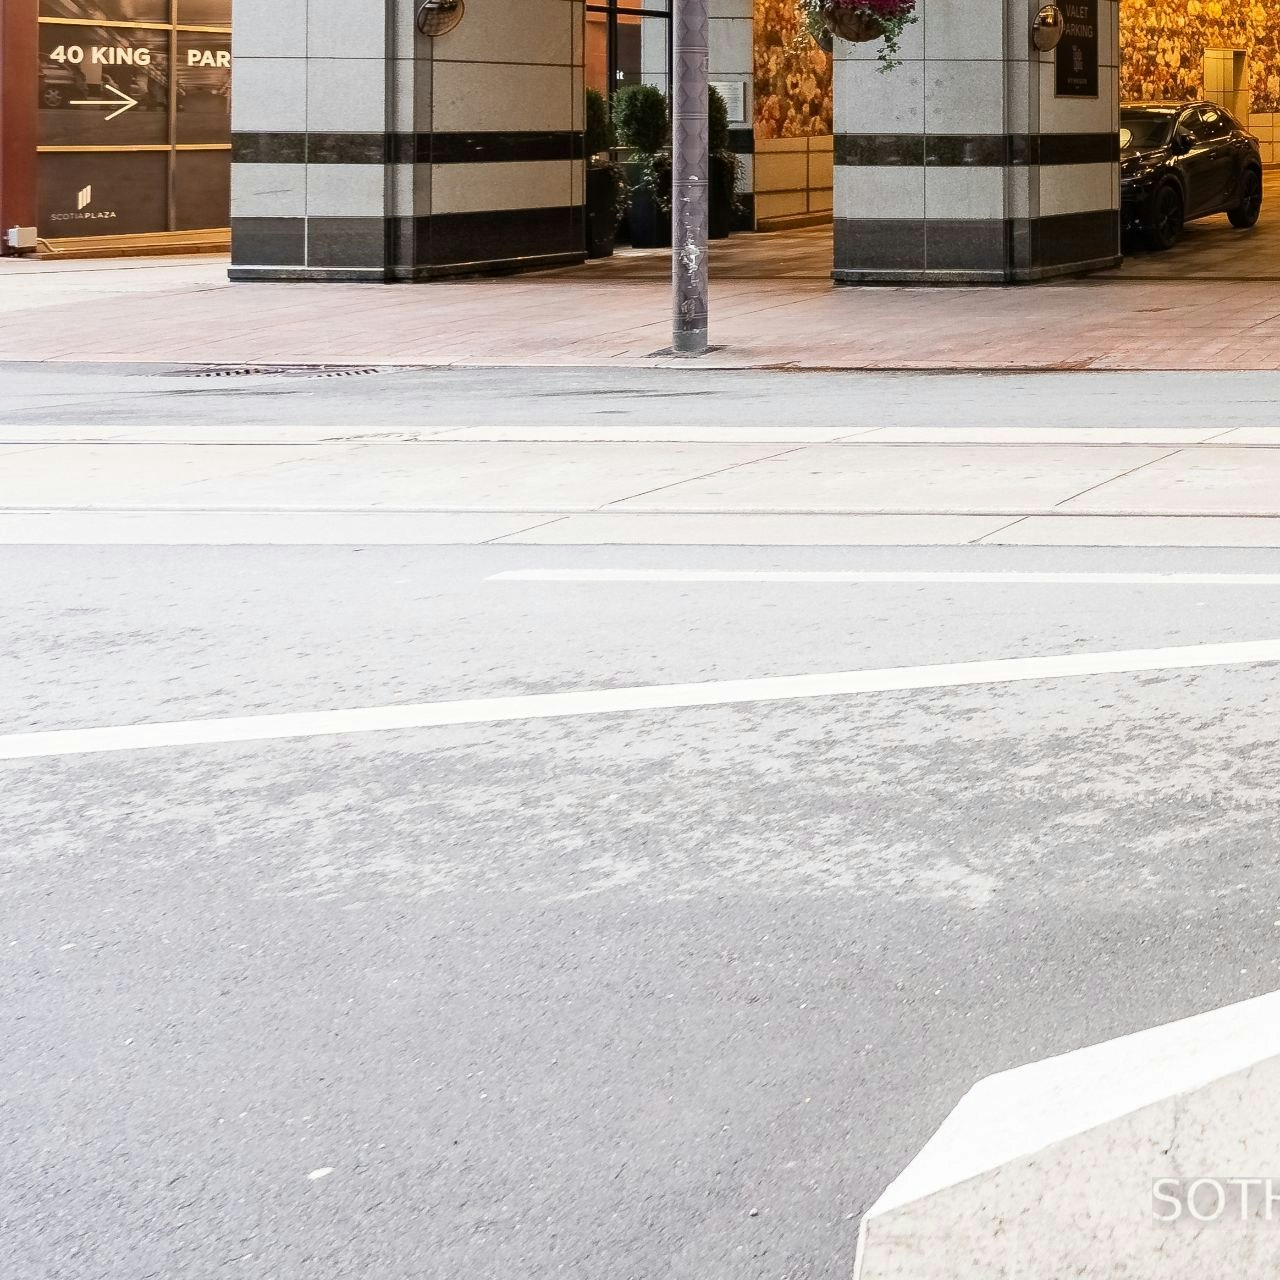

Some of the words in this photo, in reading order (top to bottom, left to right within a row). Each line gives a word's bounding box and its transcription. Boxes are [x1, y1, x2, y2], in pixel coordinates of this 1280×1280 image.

[1066, 3, 1088, 18] VALET
[1063, 23, 1093, 38] ARKING
[50, 45, 84, 63] 40
[92, 47, 151, 66] KING
[187, 49, 231, 67] PAR
